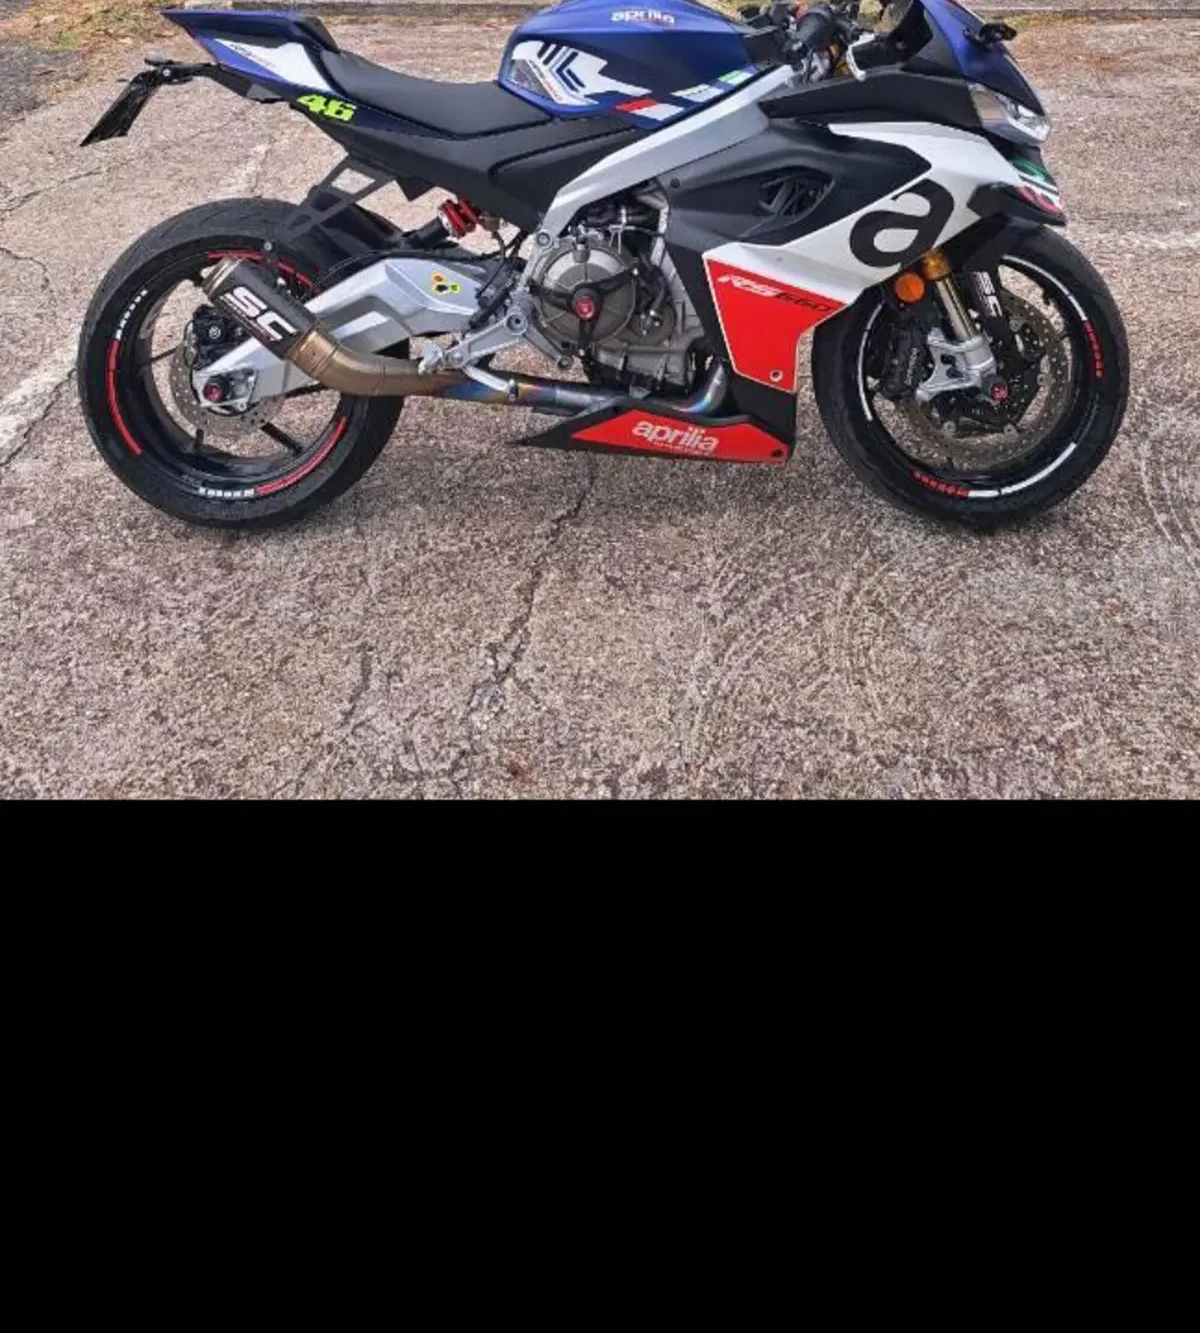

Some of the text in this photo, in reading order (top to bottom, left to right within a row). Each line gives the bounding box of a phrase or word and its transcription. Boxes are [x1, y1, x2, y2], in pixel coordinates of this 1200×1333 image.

[611, 9, 675, 26] aprilia
[296, 94, 357, 122] 46
[223, 286, 299, 342] SC
[632, 421, 719, 452] aprilia
